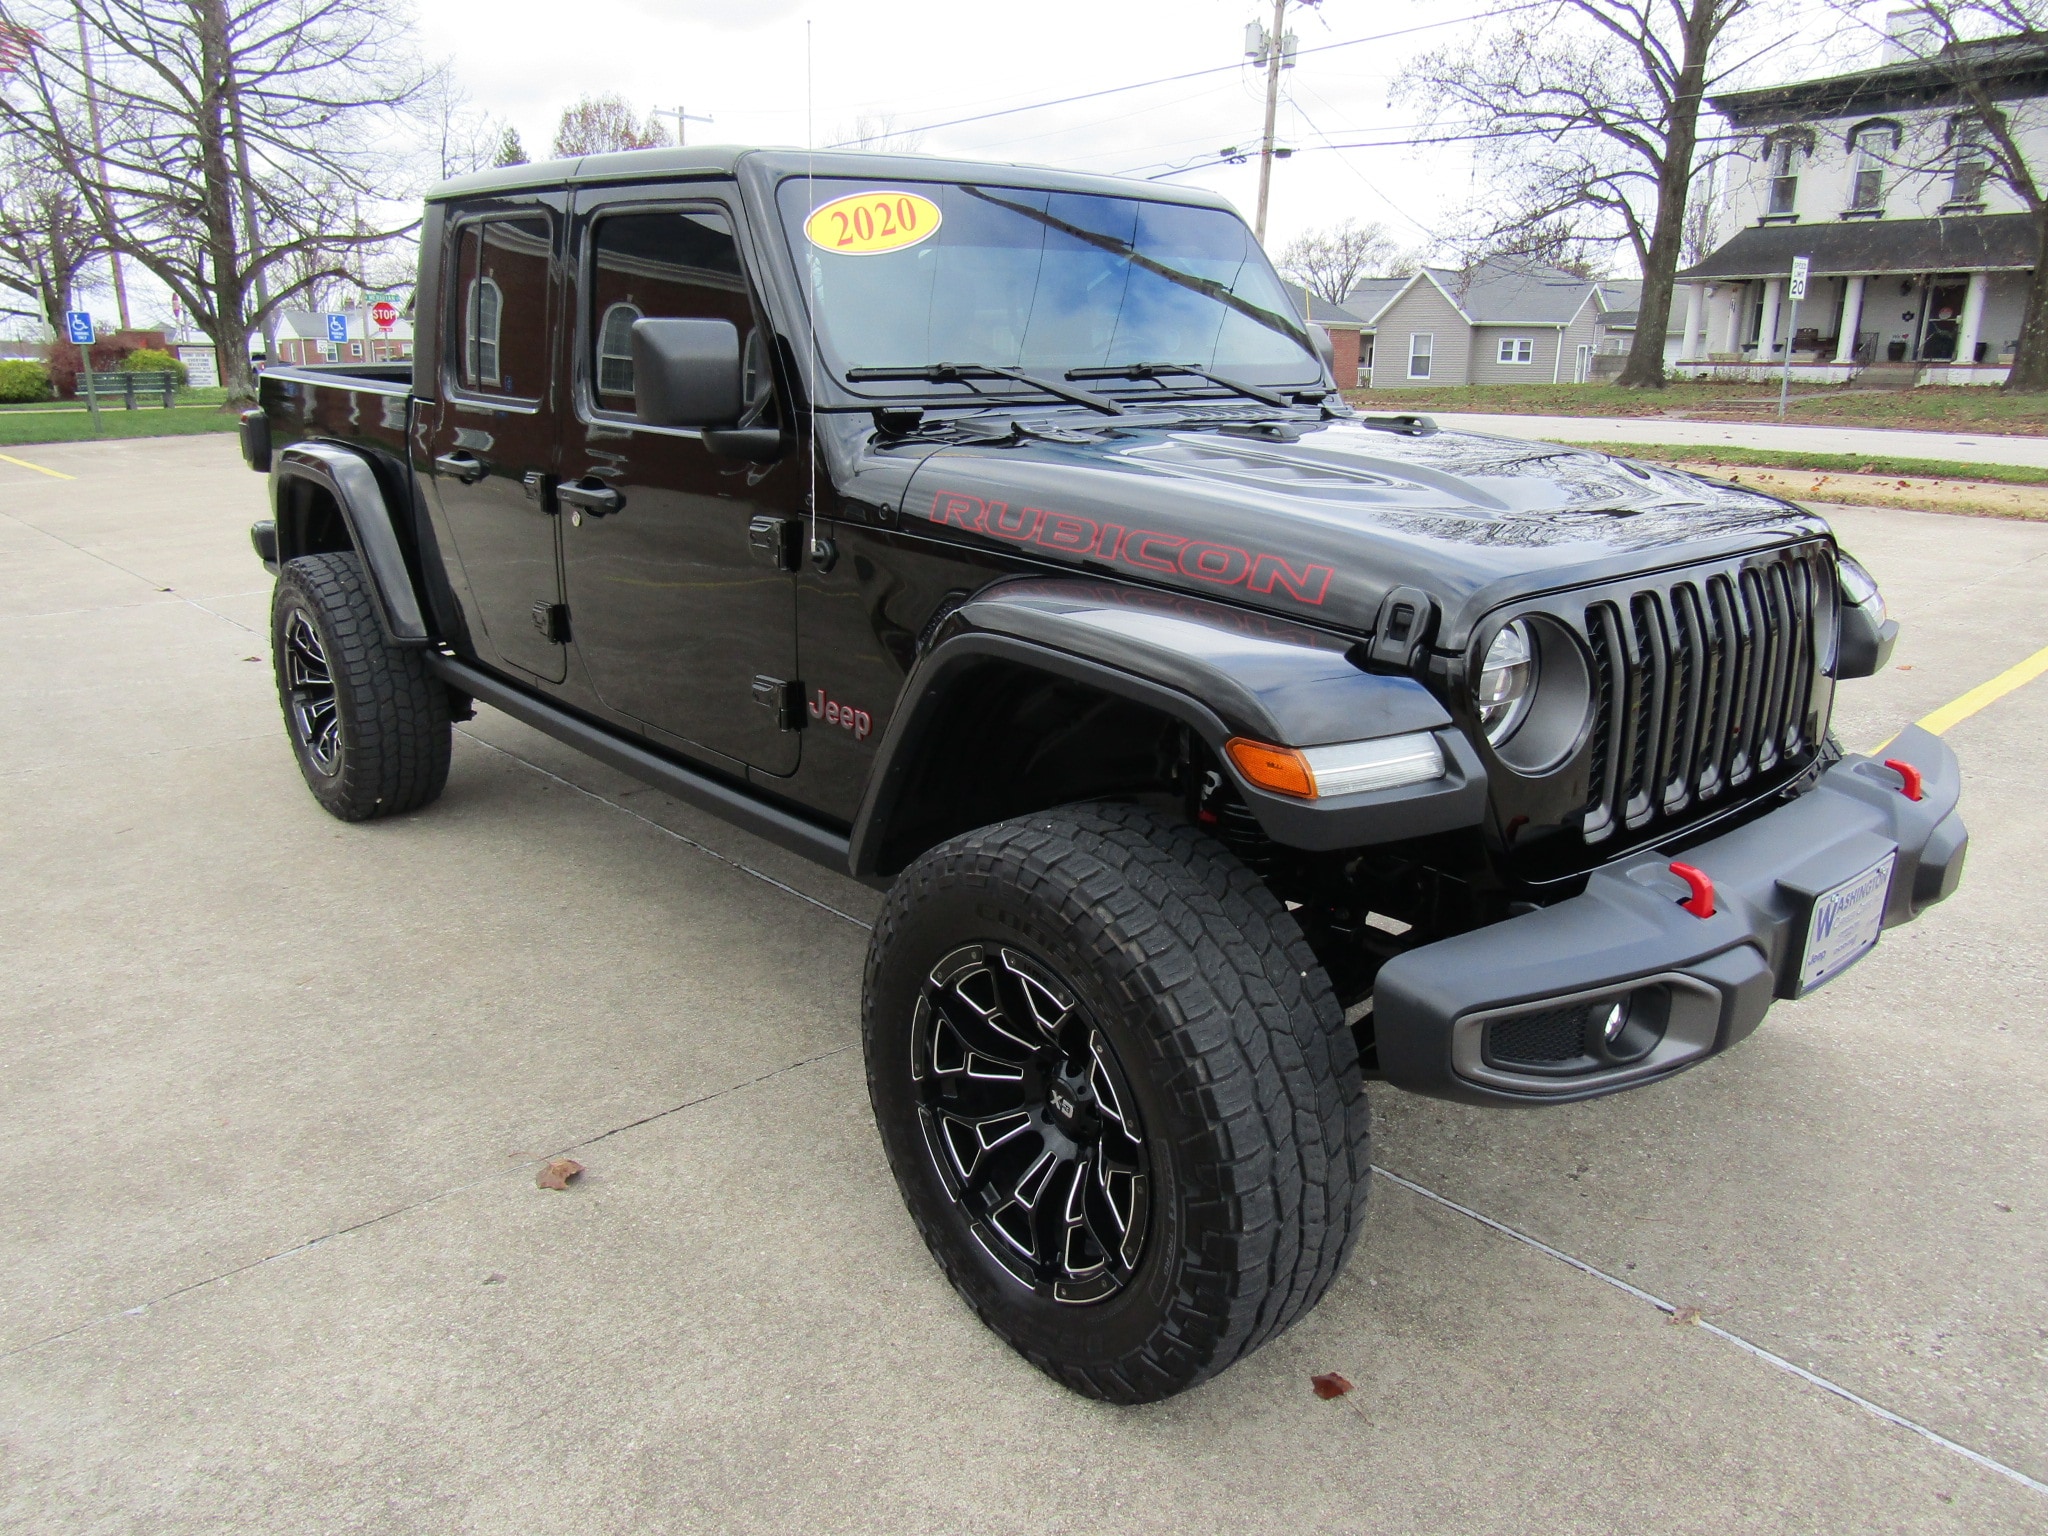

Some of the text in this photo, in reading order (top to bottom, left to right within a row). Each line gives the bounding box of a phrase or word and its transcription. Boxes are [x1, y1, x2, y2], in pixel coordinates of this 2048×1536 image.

[831, 198, 916, 246] 2020
[1791, 279, 1804, 295] 20
[373, 309, 396, 320] STOP
[929, 490, 1334, 606] RUBICON
[809, 689, 873, 741] Jeep
[1816, 869, 1888, 942] WASHINGTON
[1808, 950, 1826, 966] Jeep
